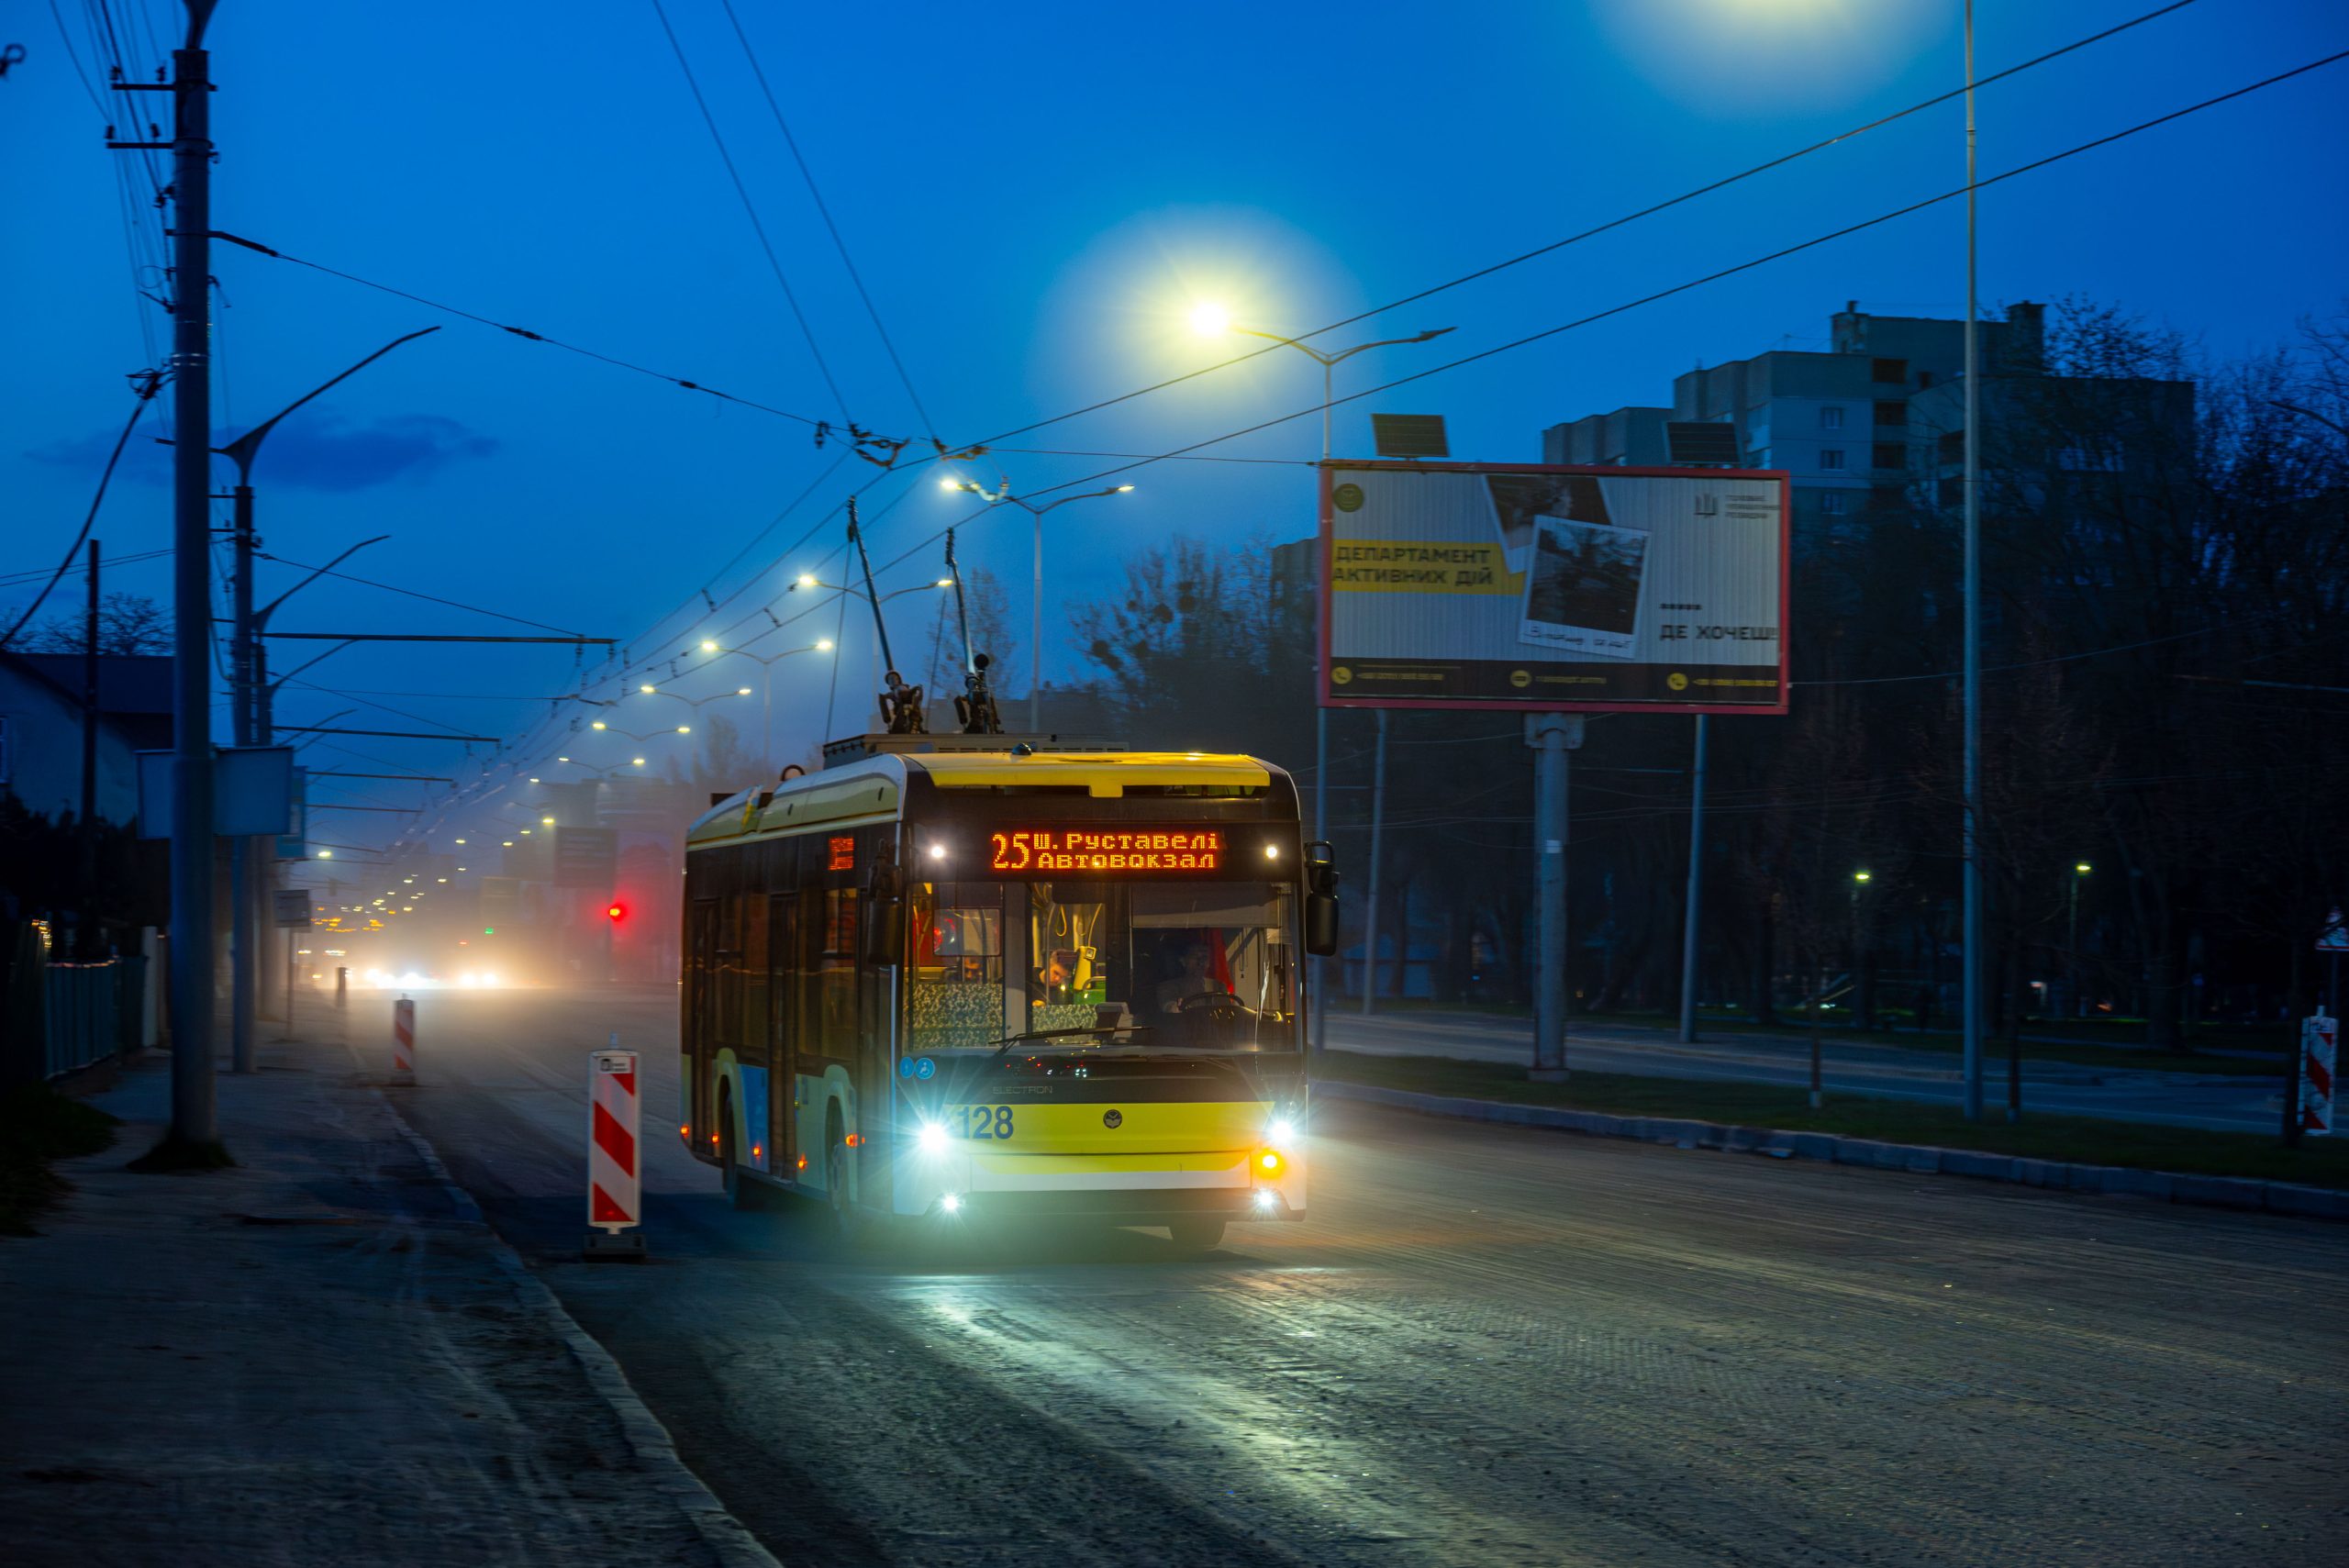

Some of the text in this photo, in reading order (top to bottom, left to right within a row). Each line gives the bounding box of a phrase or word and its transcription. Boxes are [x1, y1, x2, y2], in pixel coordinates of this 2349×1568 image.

[1336, 546, 1491, 564] ДЕПАРТАМЕНТ
[1333, 567, 1494, 587] АКТИВНИХ ДІЙ
[1659, 625, 1688, 640] ДЕ
[1033, 833, 1218, 850] Ш. Руставелі
[992, 833, 1030, 869] 25
[1038, 852, 1214, 869] Автовокзал
[992, 1085, 1053, 1095] ELECTRON
[957, 1106, 1014, 1140] 128
